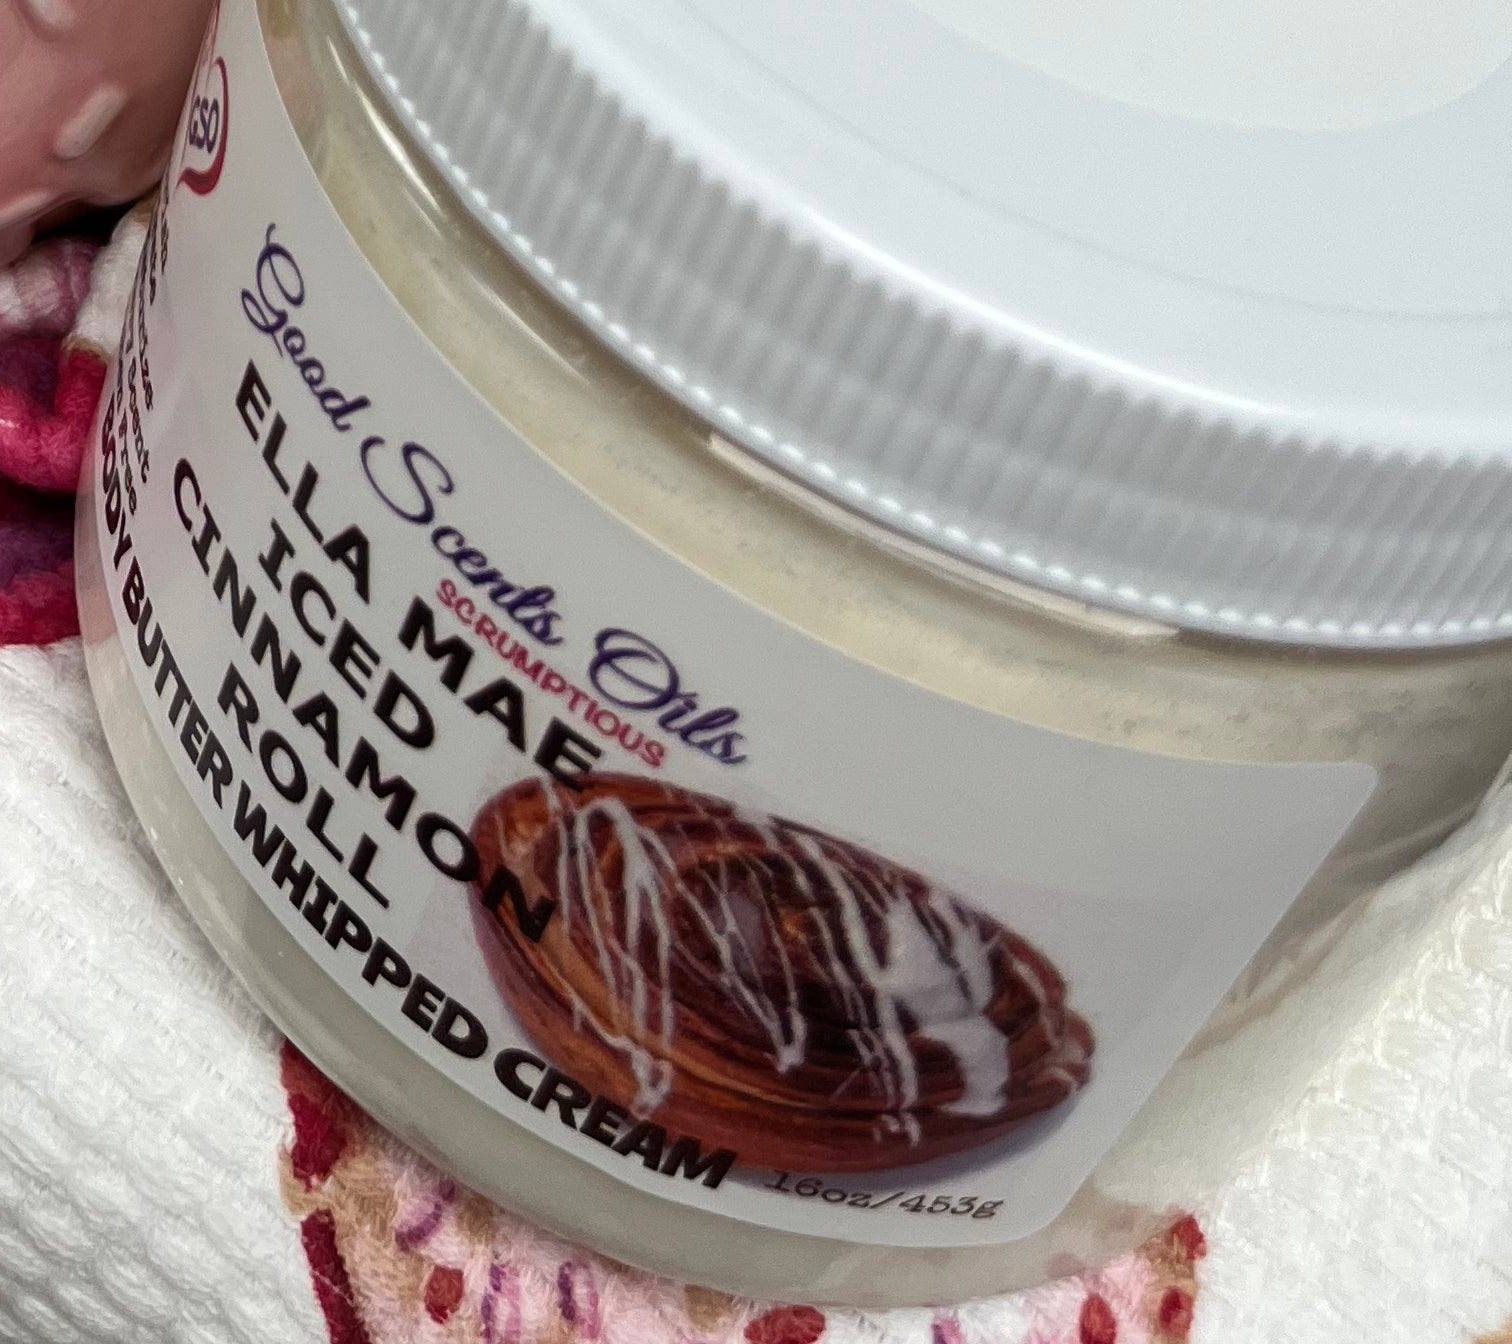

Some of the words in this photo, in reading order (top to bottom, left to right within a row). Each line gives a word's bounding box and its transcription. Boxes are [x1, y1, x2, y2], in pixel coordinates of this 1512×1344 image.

[235, 360, 372, 606] ELLA
[397, 594, 603, 794] MAE
[241, 223, 371, 433] Good
[360, 435, 564, 647] Scents
[589, 627, 748, 766] Oils
[259, 517, 437, 750] ICED
[102, 389, 133, 571] BODY
[121, 555, 234, 811] BUTTER
[233, 779, 489, 1060] WHIPPED
[493, 1046, 738, 1191] CREAM
[173, 456, 556, 944] CINNAMON
[217, 662, 390, 910] ROLL
[435, 578, 667, 768] SCRUMPTIOUS
[764, 1169, 1005, 1220] 16oz/453g
